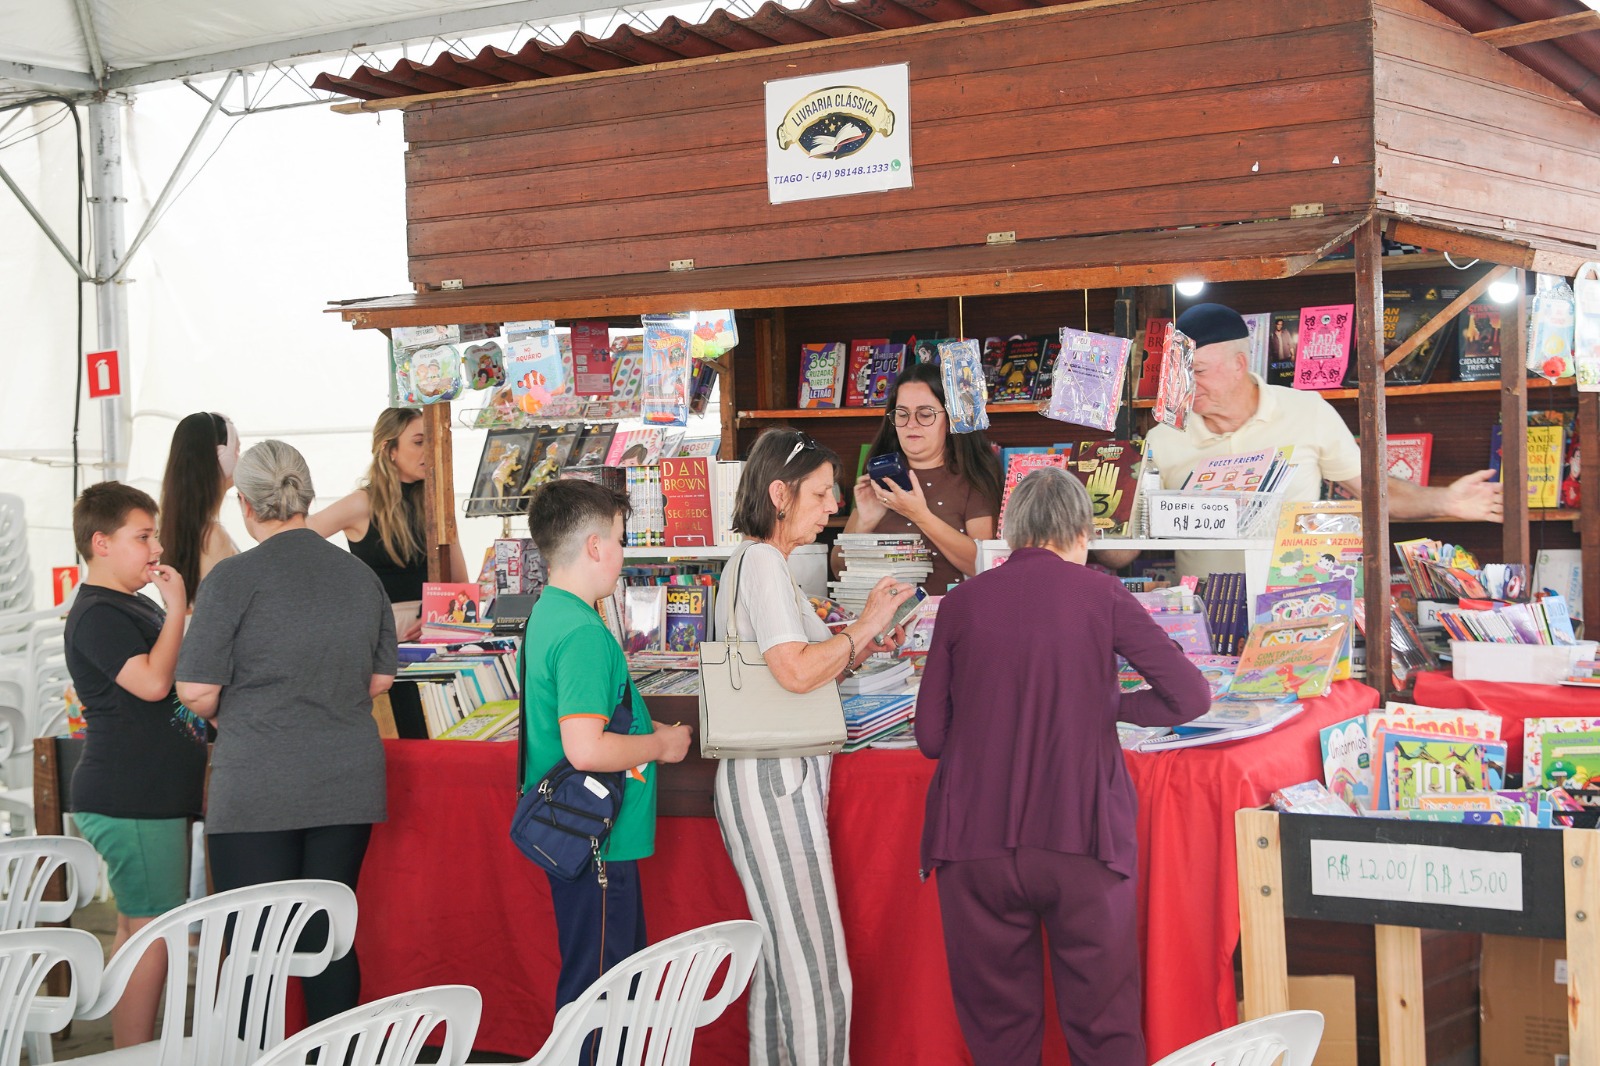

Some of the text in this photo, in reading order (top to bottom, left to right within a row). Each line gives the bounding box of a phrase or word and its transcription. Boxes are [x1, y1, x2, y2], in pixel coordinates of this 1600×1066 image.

[792, 92, 878, 127] LIVRARIA CLÁSSICA
[774, 173, 803, 185] TIAGO
[811, 169, 832, 181] (54)
[834, 163, 889, 178] 98148.1333
[1311, 328, 1340, 347] LADY
[515, 352, 542, 363] AQUÁRIO
[1302, 343, 1343, 360] KILLERS
[809, 351, 837, 369] 365
[1459, 356, 1486, 366] CIDADE
[806, 368, 834, 379] CRUZADAS
[1466, 363, 1495, 371] TREVAS
[810, 377, 833, 388] DIRETAS
[809, 387, 833, 399] LETRÃO
[1021, 459, 1052, 467] DIÁRIO
[1208, 454, 1265, 468] FUZZY FRIENDS
[662, 461, 705, 476] DAN
[663, 479, 706, 492] BROWN
[1093, 493, 1111, 516] 3
[1160, 500, 1229, 511] BOBBIE GOODS
[1173, 515, 1226, 531] R$ 20,00
[1281, 538, 1318, 546] ANIMAIS
[1257, 649, 1304, 660] CONTANDO
[1411, 761, 1459, 794] 101
[1327, 854, 1350, 881] R$
[1425, 861, 1450, 893] R$
[1459, 867, 1508, 894] 15,00
